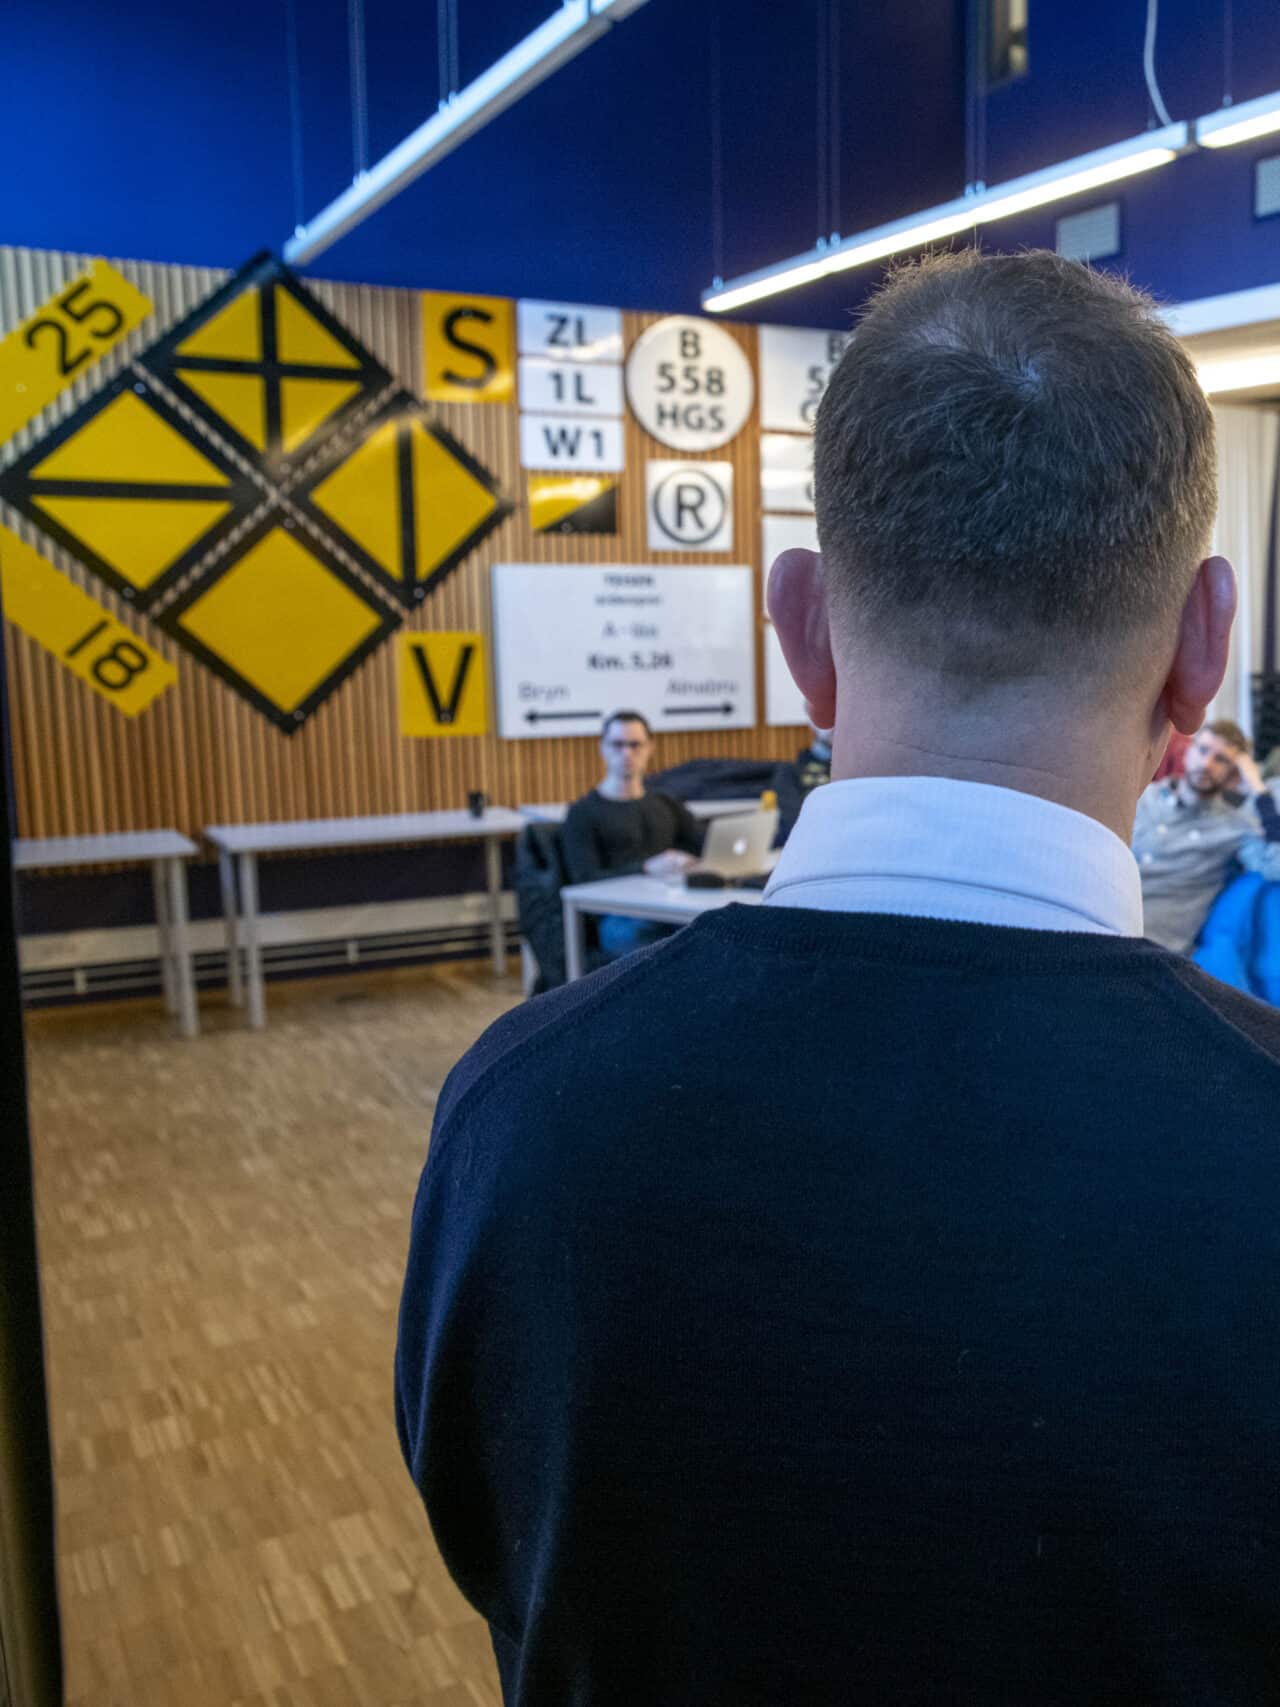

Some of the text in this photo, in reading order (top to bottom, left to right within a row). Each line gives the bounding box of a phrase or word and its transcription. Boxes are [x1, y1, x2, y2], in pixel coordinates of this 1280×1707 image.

[24, 282, 125, 375] 25
[442, 307, 497, 389] S
[680, 330, 701, 359] B
[549, 370, 594, 404] 1L
[657, 363, 725, 397] 558
[657, 403, 726, 432] HGS
[543, 426, 604, 459] W1
[675, 484, 707, 530] R
[65, 619, 151, 691] 18
[411, 643, 475, 725] V
